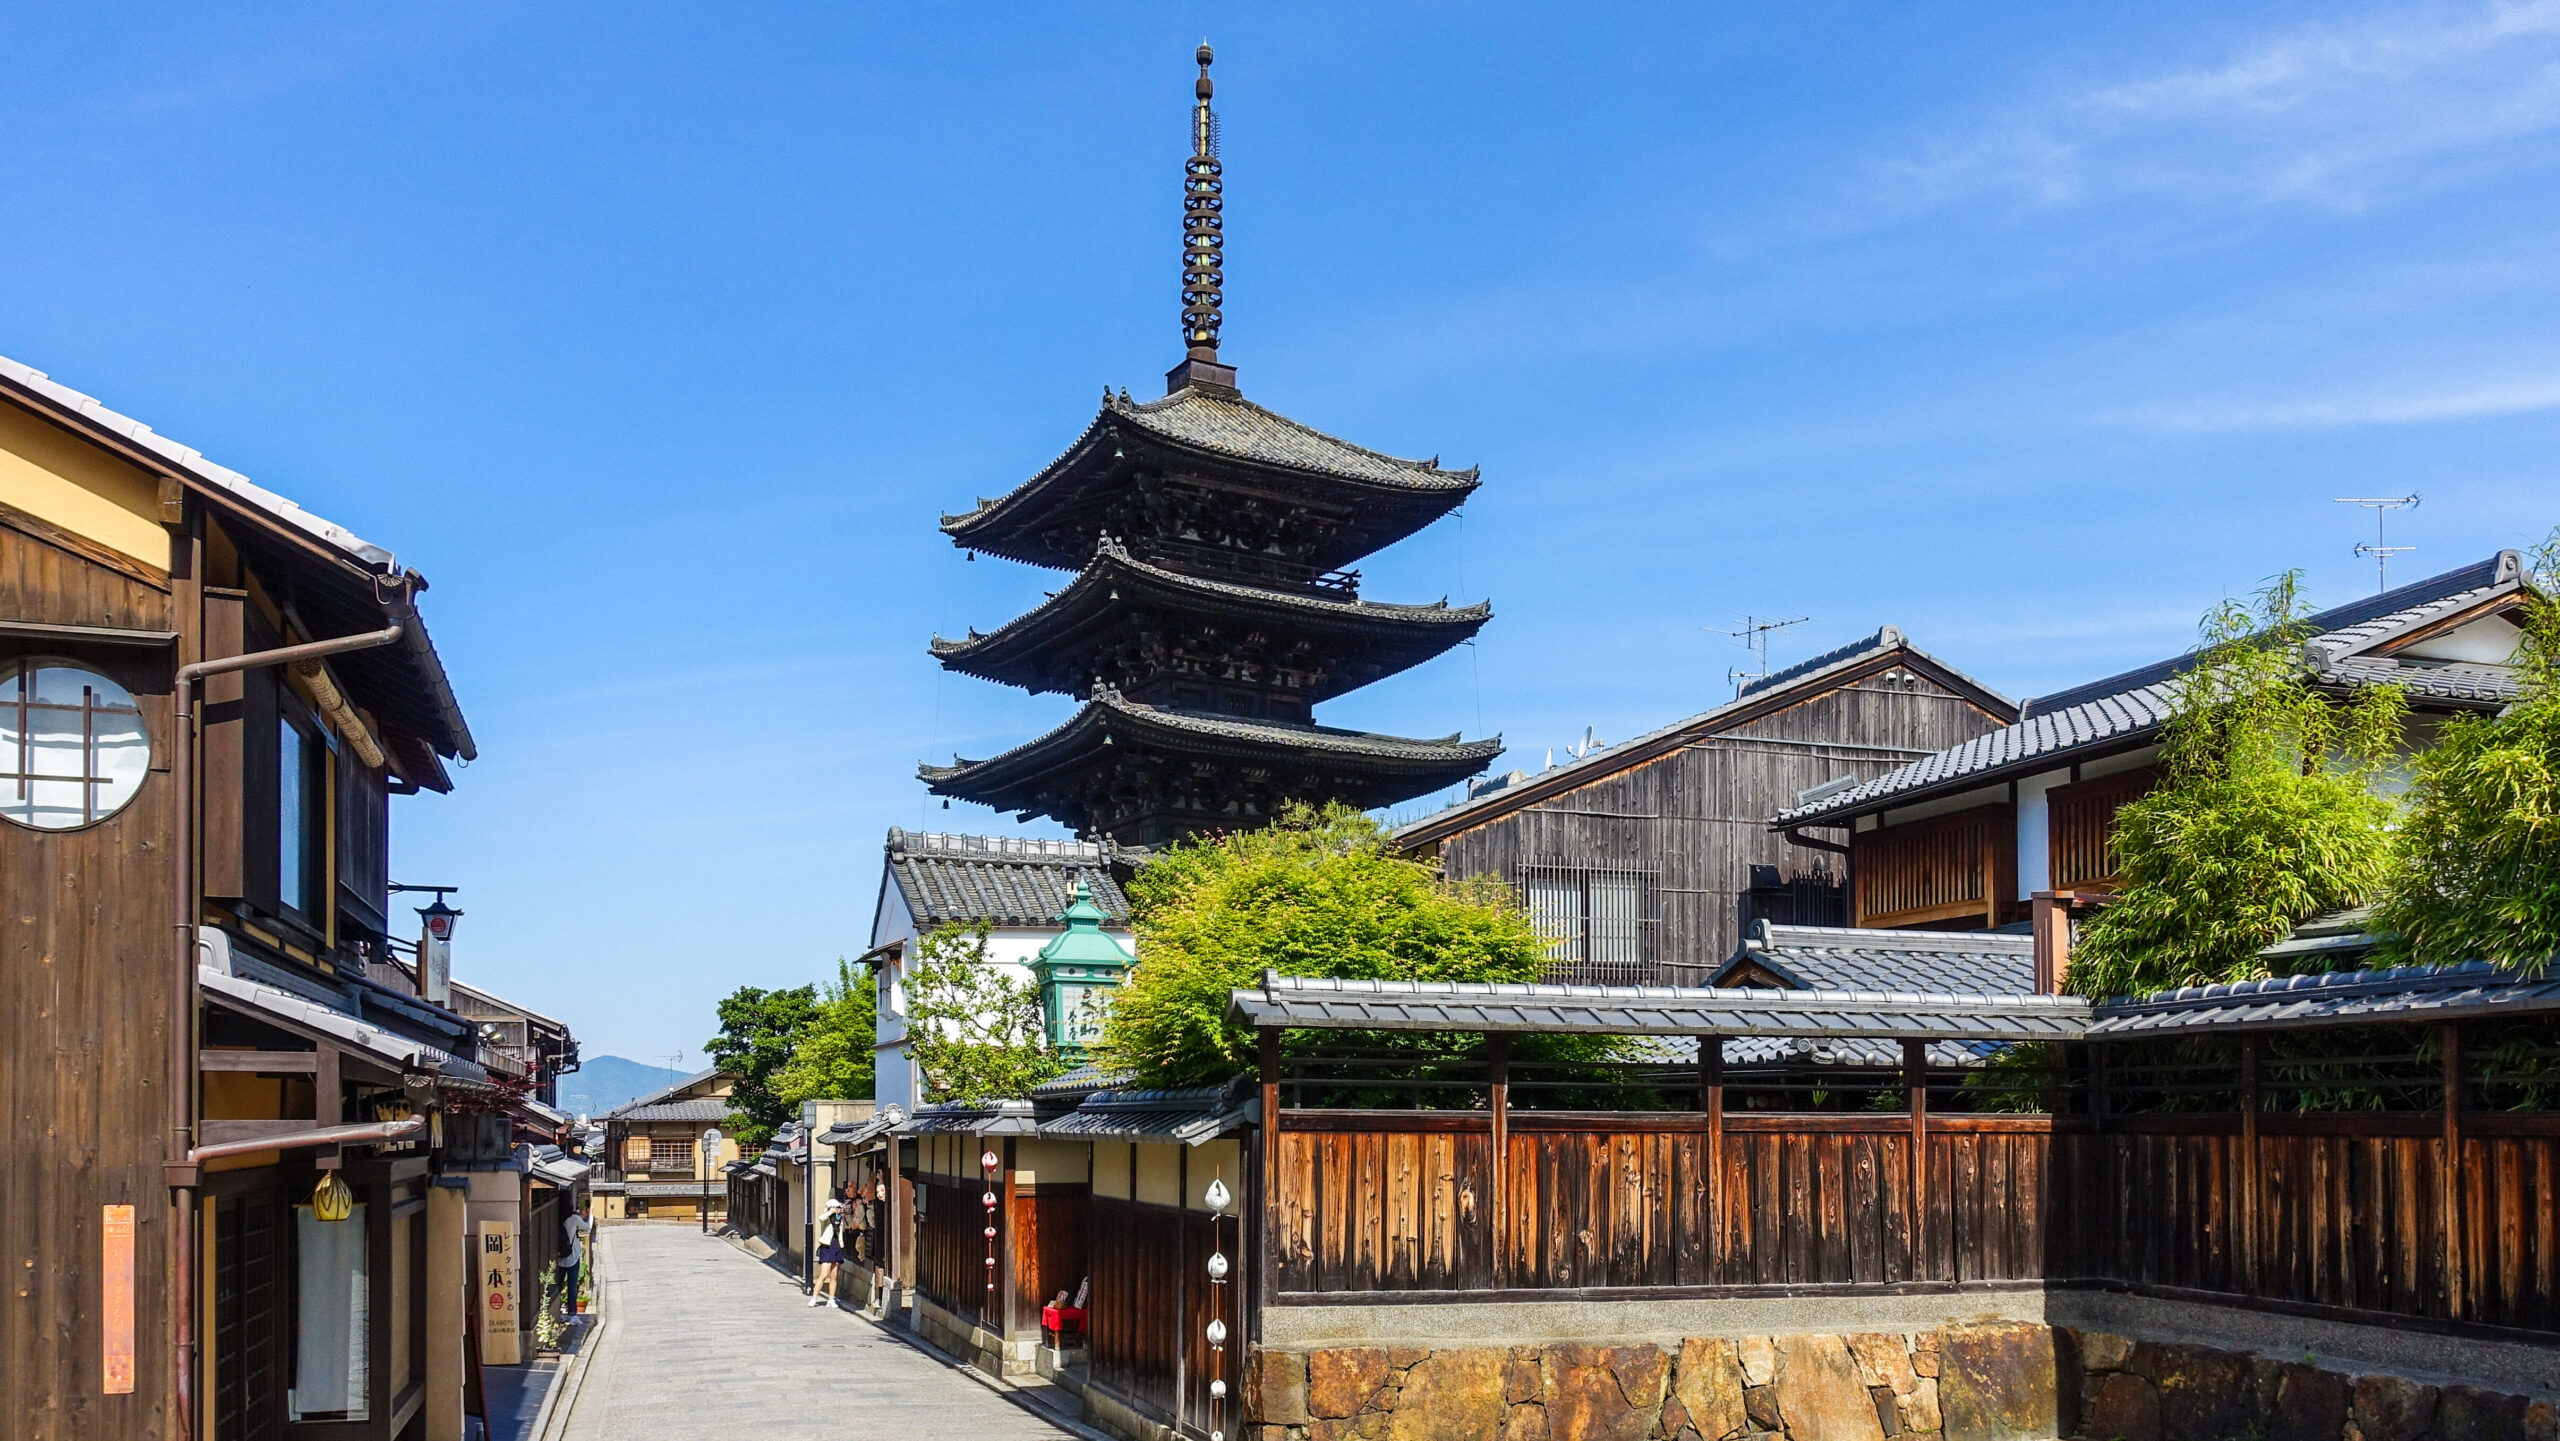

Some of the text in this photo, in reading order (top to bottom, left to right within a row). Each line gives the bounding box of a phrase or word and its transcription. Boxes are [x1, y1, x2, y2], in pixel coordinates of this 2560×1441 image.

[485, 1233, 504, 1288] 岡本
[504, 1231, 514, 1312] レンタルきもの
